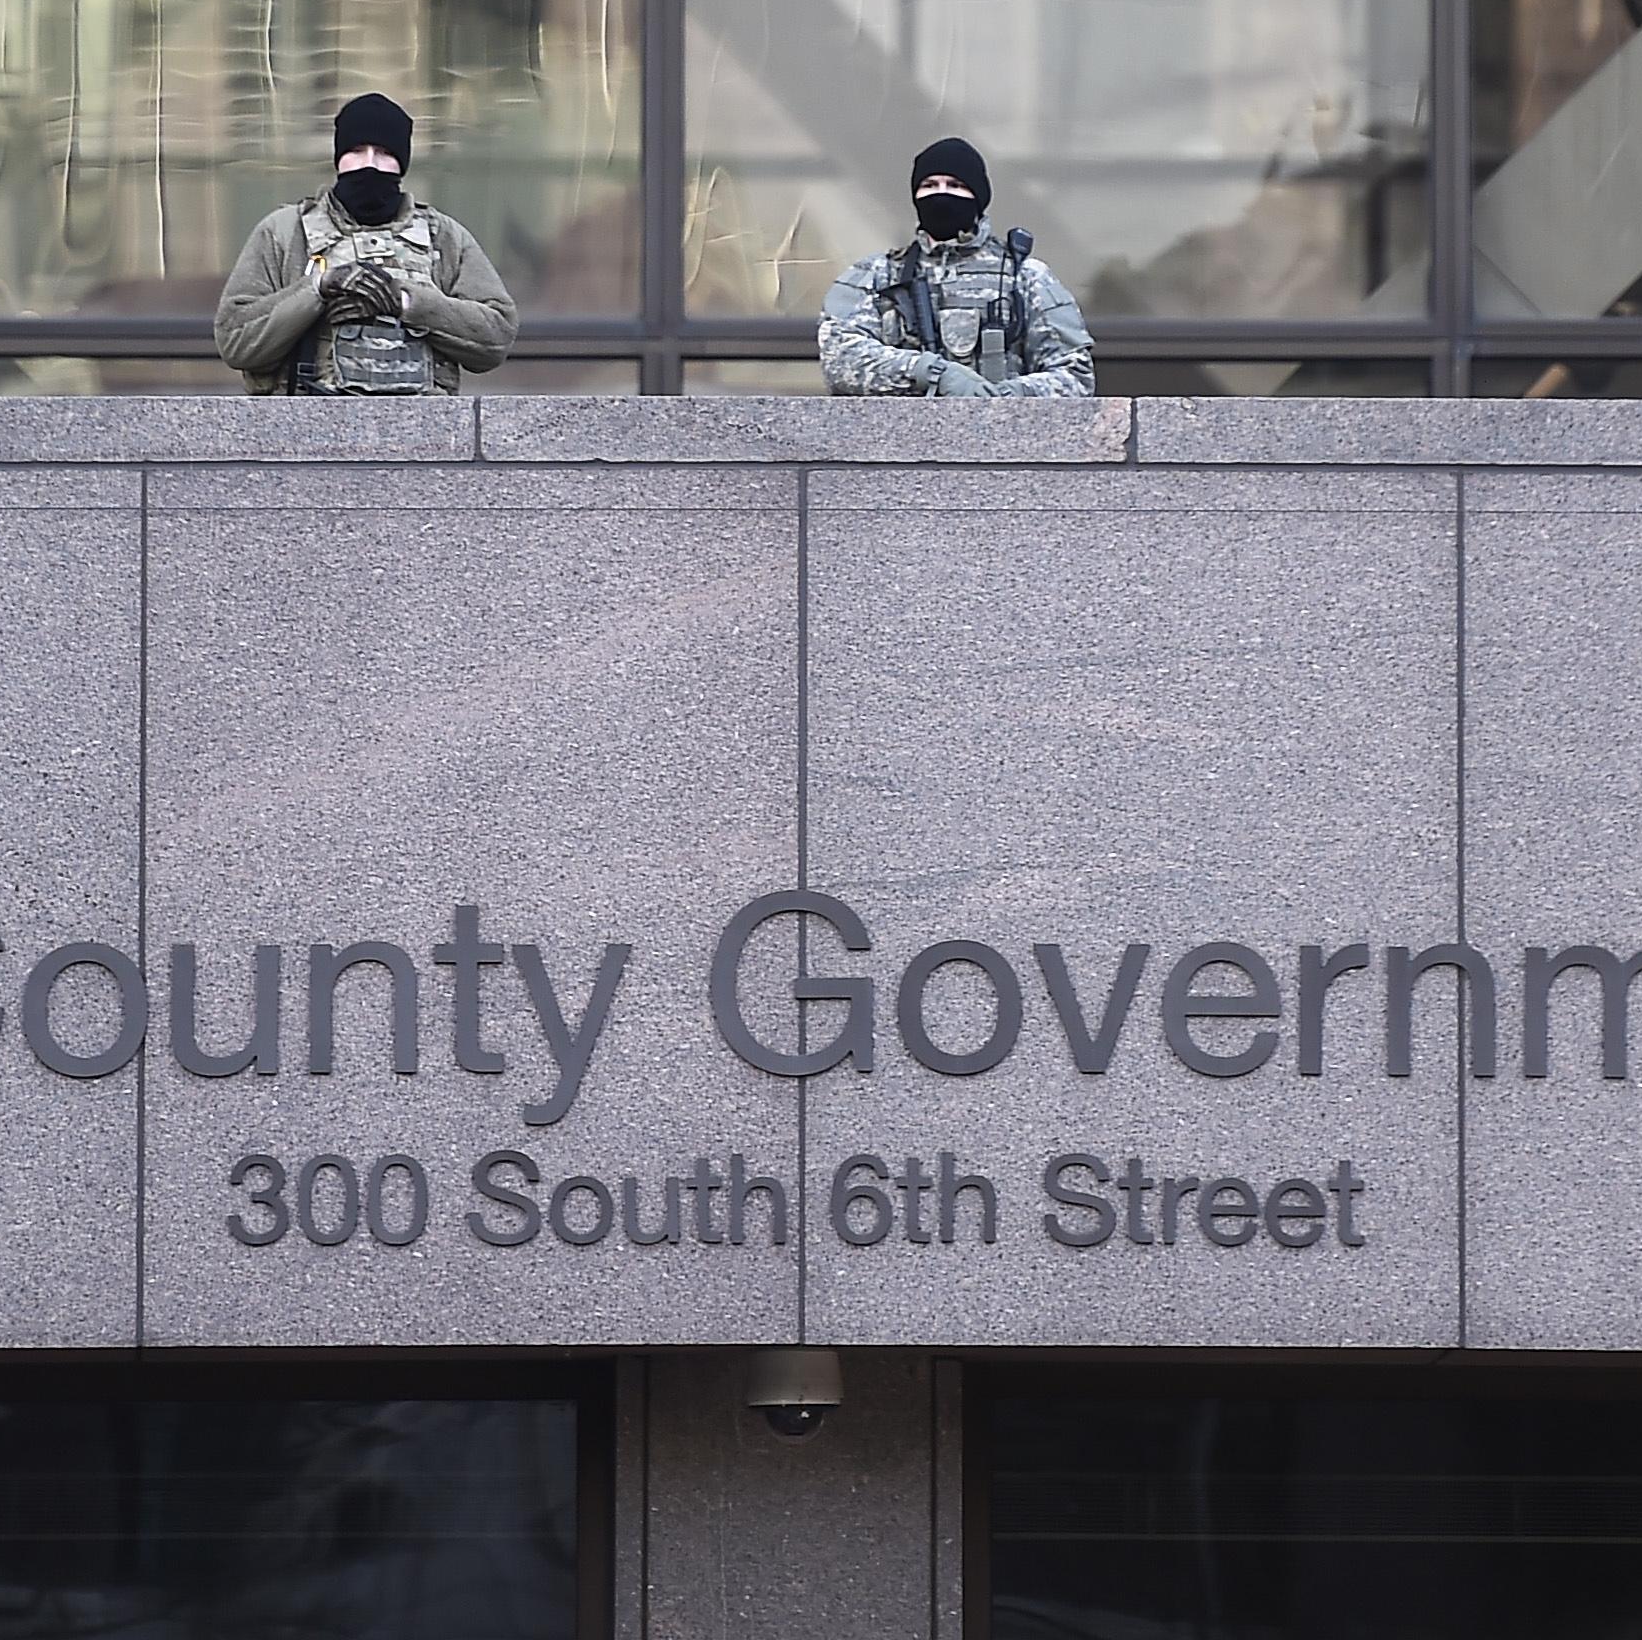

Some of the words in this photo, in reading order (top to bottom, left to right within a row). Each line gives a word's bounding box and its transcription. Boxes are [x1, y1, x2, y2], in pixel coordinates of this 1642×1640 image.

[225, 1152, 430, 1247] 300
[465, 1149, 788, 1247] South
[828, 1151, 998, 1247] 6th
[1042, 1151, 1367, 1248] Street
